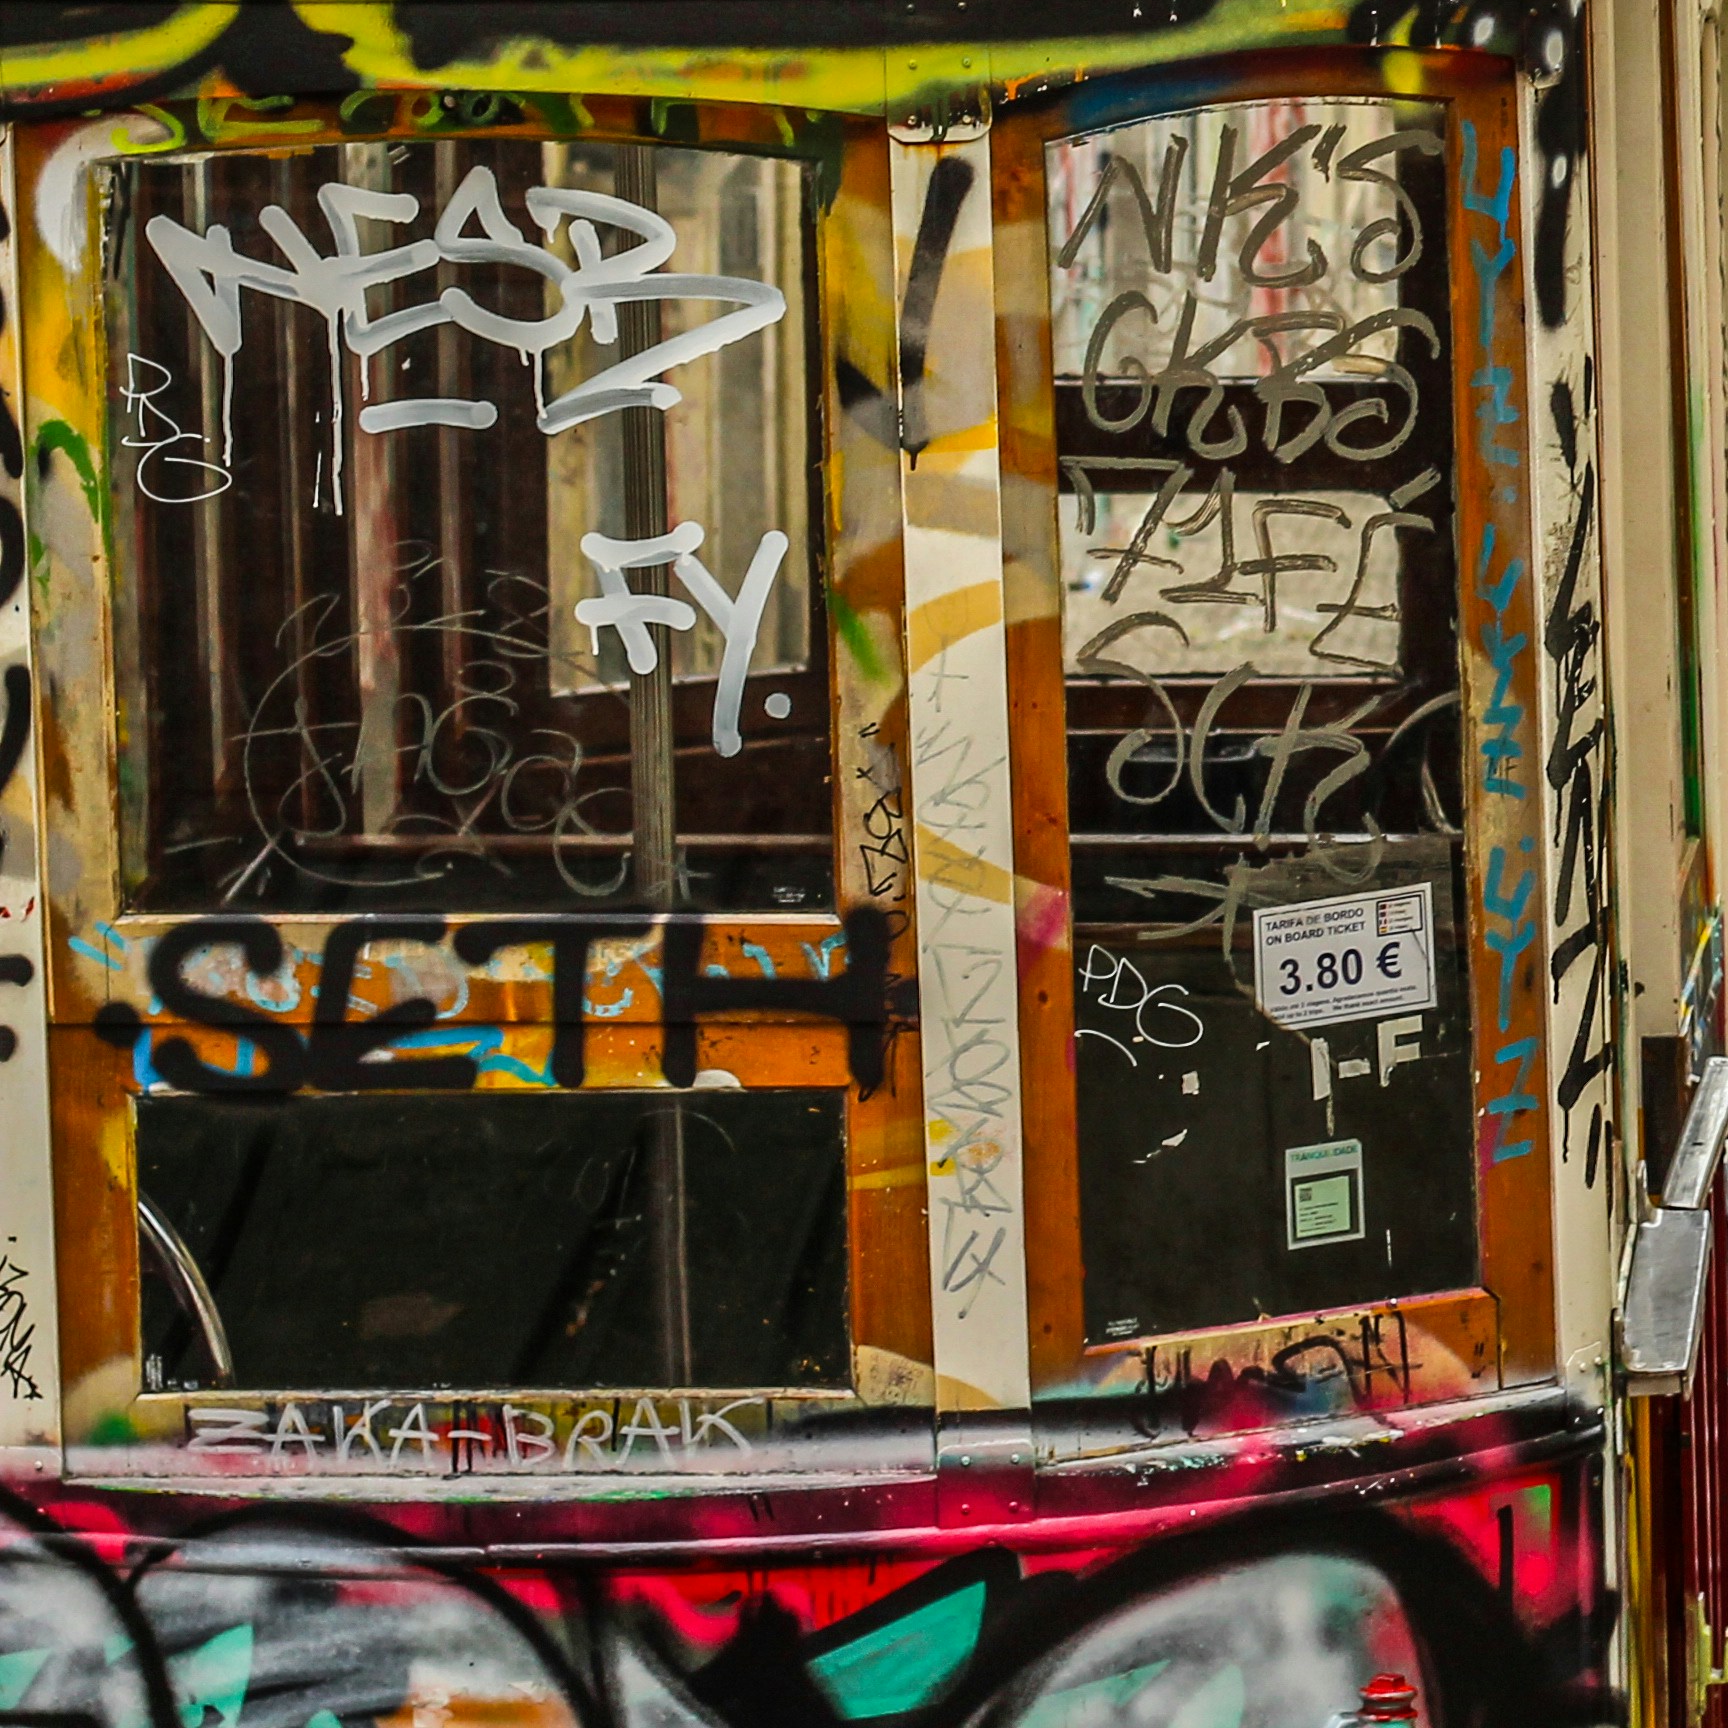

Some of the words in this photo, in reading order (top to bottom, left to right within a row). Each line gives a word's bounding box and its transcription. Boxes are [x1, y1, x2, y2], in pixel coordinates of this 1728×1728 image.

[1266, 918, 1304, 932] TARIFA
[1306, 914, 1322, 926] DE
[1324, 908, 1364, 922] BORDO
[1266, 934, 1282, 946] ON
[1284, 929, 1324, 943] BOARD
[1327, 921, 1366, 936] TICKET
[1279, 948, 1363, 995] 3.80
[1376, 942, 1402, 979] €
